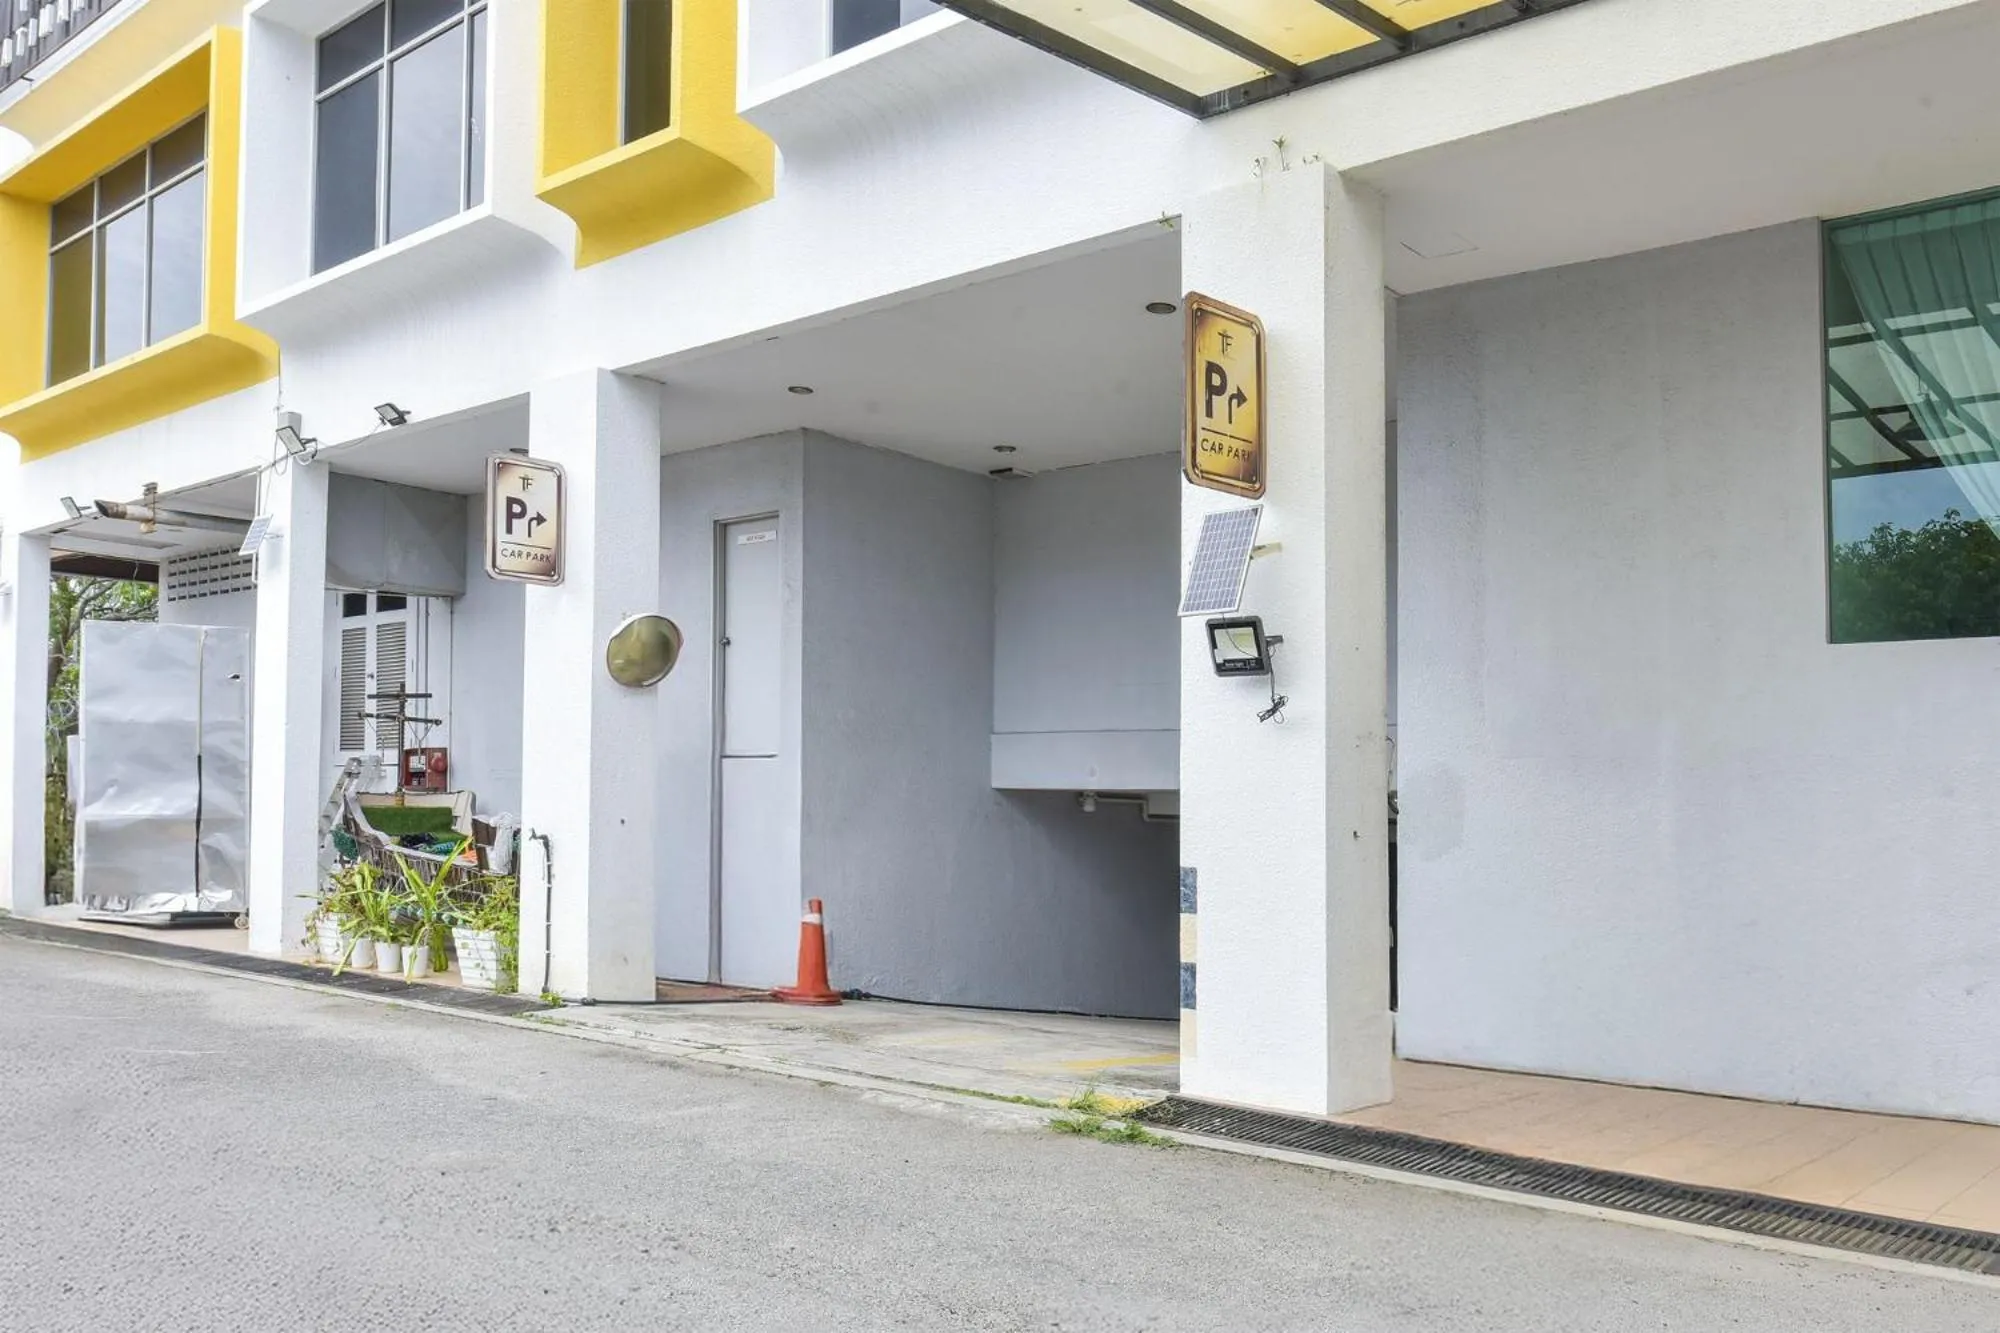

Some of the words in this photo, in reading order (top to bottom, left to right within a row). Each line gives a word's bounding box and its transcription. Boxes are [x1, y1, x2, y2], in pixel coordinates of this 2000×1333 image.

[1205, 360, 1228, 419] P
[1201, 438, 1224, 456] CAR
[506, 496, 527, 535] P
[501, 548, 523, 559] CAR
[526, 551, 552, 563] PARK
